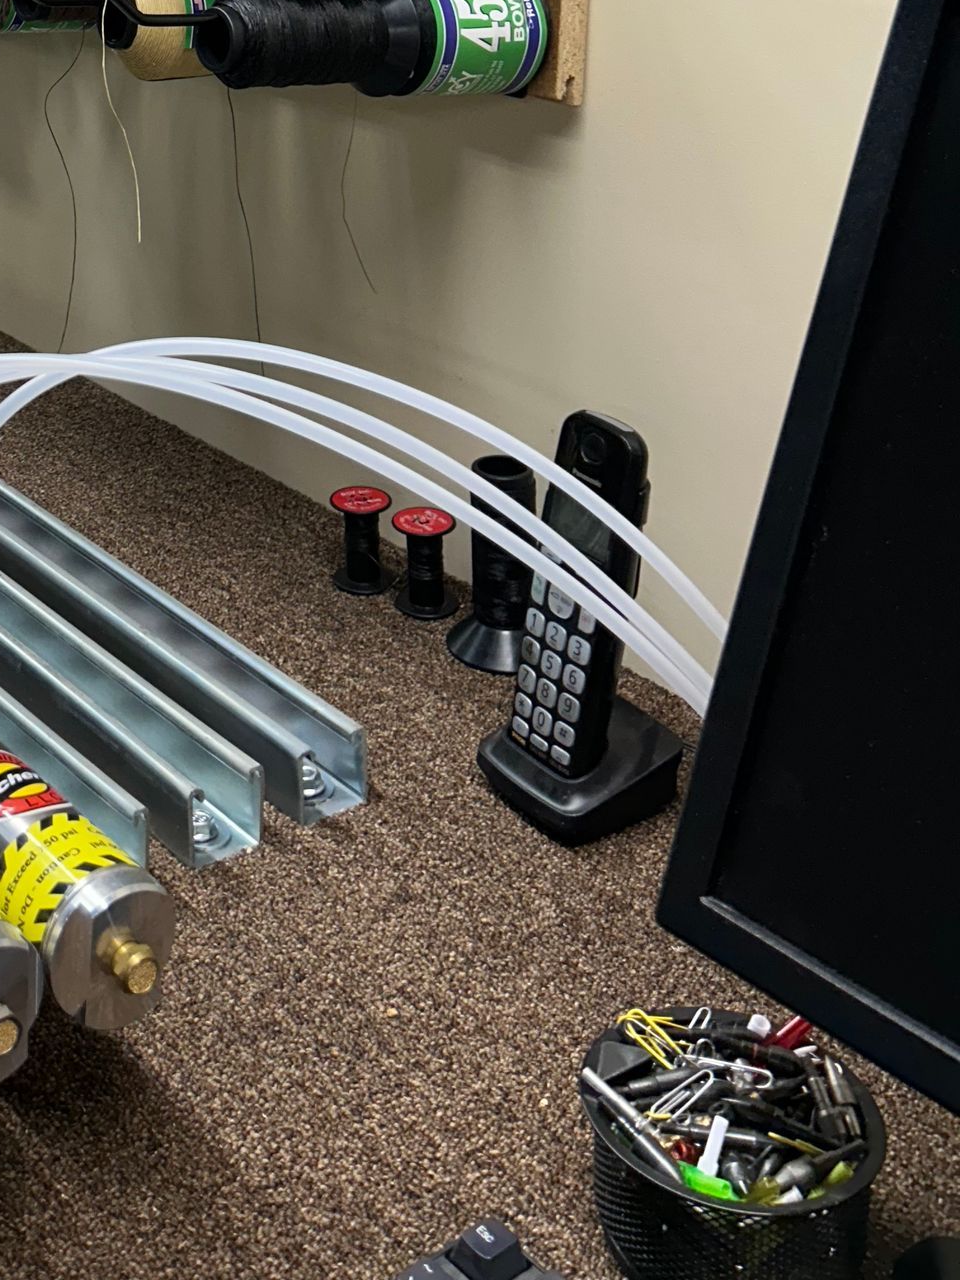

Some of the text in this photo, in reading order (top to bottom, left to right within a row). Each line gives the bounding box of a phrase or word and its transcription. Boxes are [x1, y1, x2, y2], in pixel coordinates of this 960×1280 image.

[531, 613, 582, 656] 1 2 3
[526, 641, 577, 685] 4 5 6
[521, 670, 573, 713] 7 8 9
[537, 711, 545, 728] 0
[8, 828, 78, 895] Exceed psi
[22, 847, 81, 915] Caution Do
[476, 1225, 494, 1243] Esc
